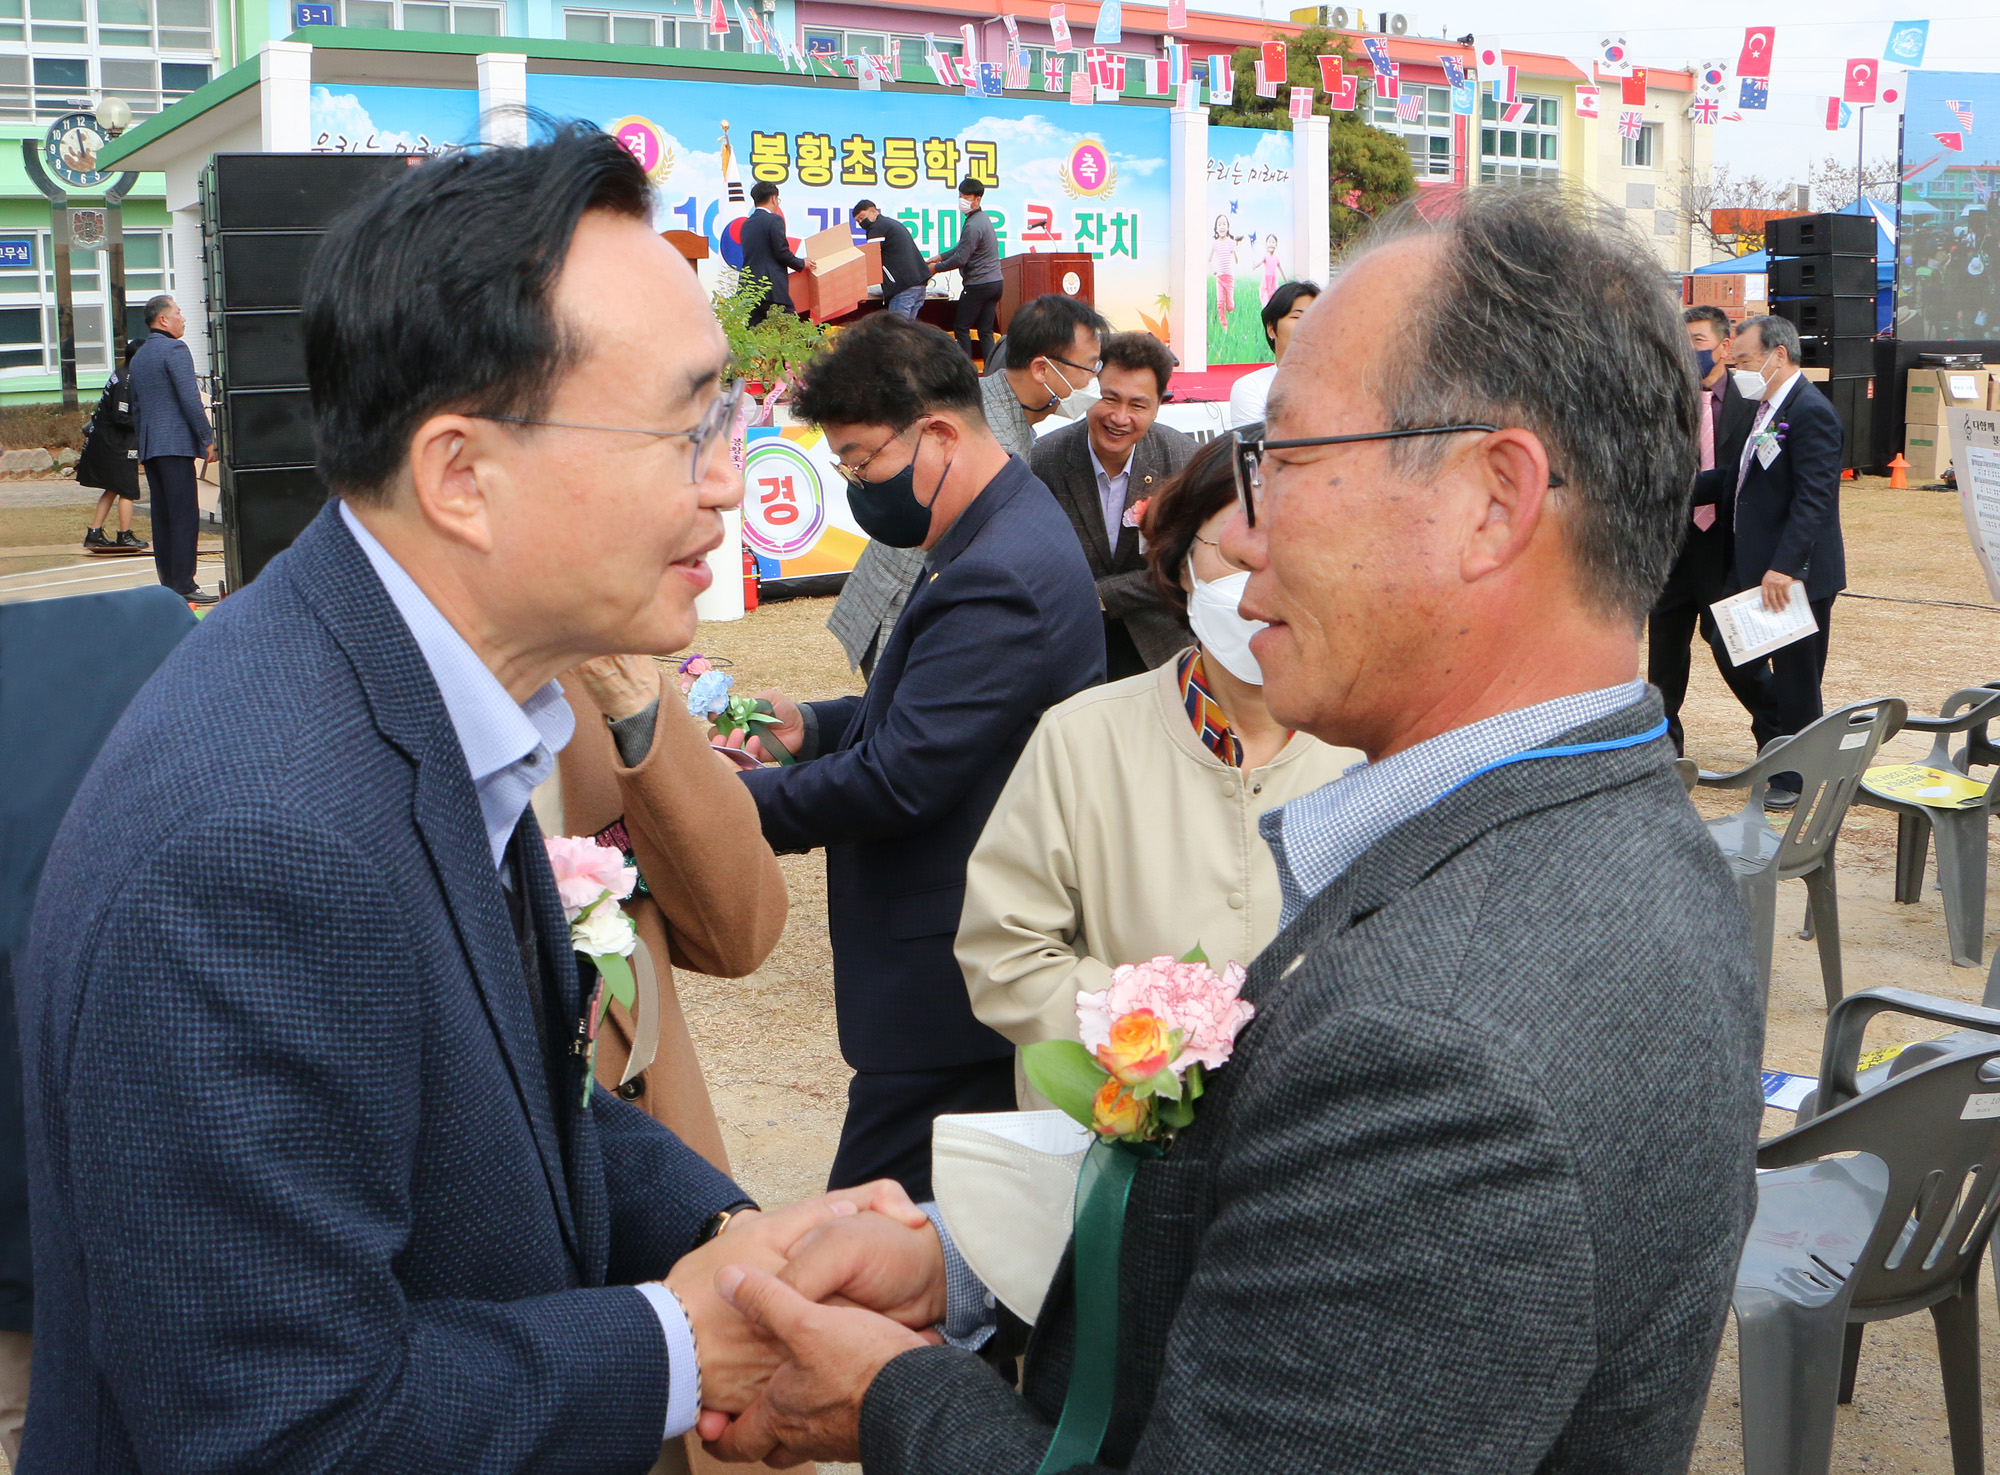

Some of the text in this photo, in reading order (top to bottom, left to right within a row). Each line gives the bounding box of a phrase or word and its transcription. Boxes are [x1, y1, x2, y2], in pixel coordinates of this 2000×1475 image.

[302, 8, 328, 23] 3-1
[812, 41, 832, 52] 2-1
[62, 119, 70, 130] 11
[76, 116, 86, 126] 12
[93, 121, 98, 131] 1
[52, 129, 61, 140] 10
[49, 144, 56, 154] 9
[624, 132, 646, 167] 경
[55, 158, 62, 170] 8
[751, 131, 999, 189] 봉황초등학교
[1079, 153, 1099, 184] 축
[1207, 159, 1290, 186] 우리는 미래다
[66, 170, 72, 180] 7
[80, 173, 87, 184] 6
[1075, 212, 1138, 260] 잔치
[757, 475, 799, 526] 경
